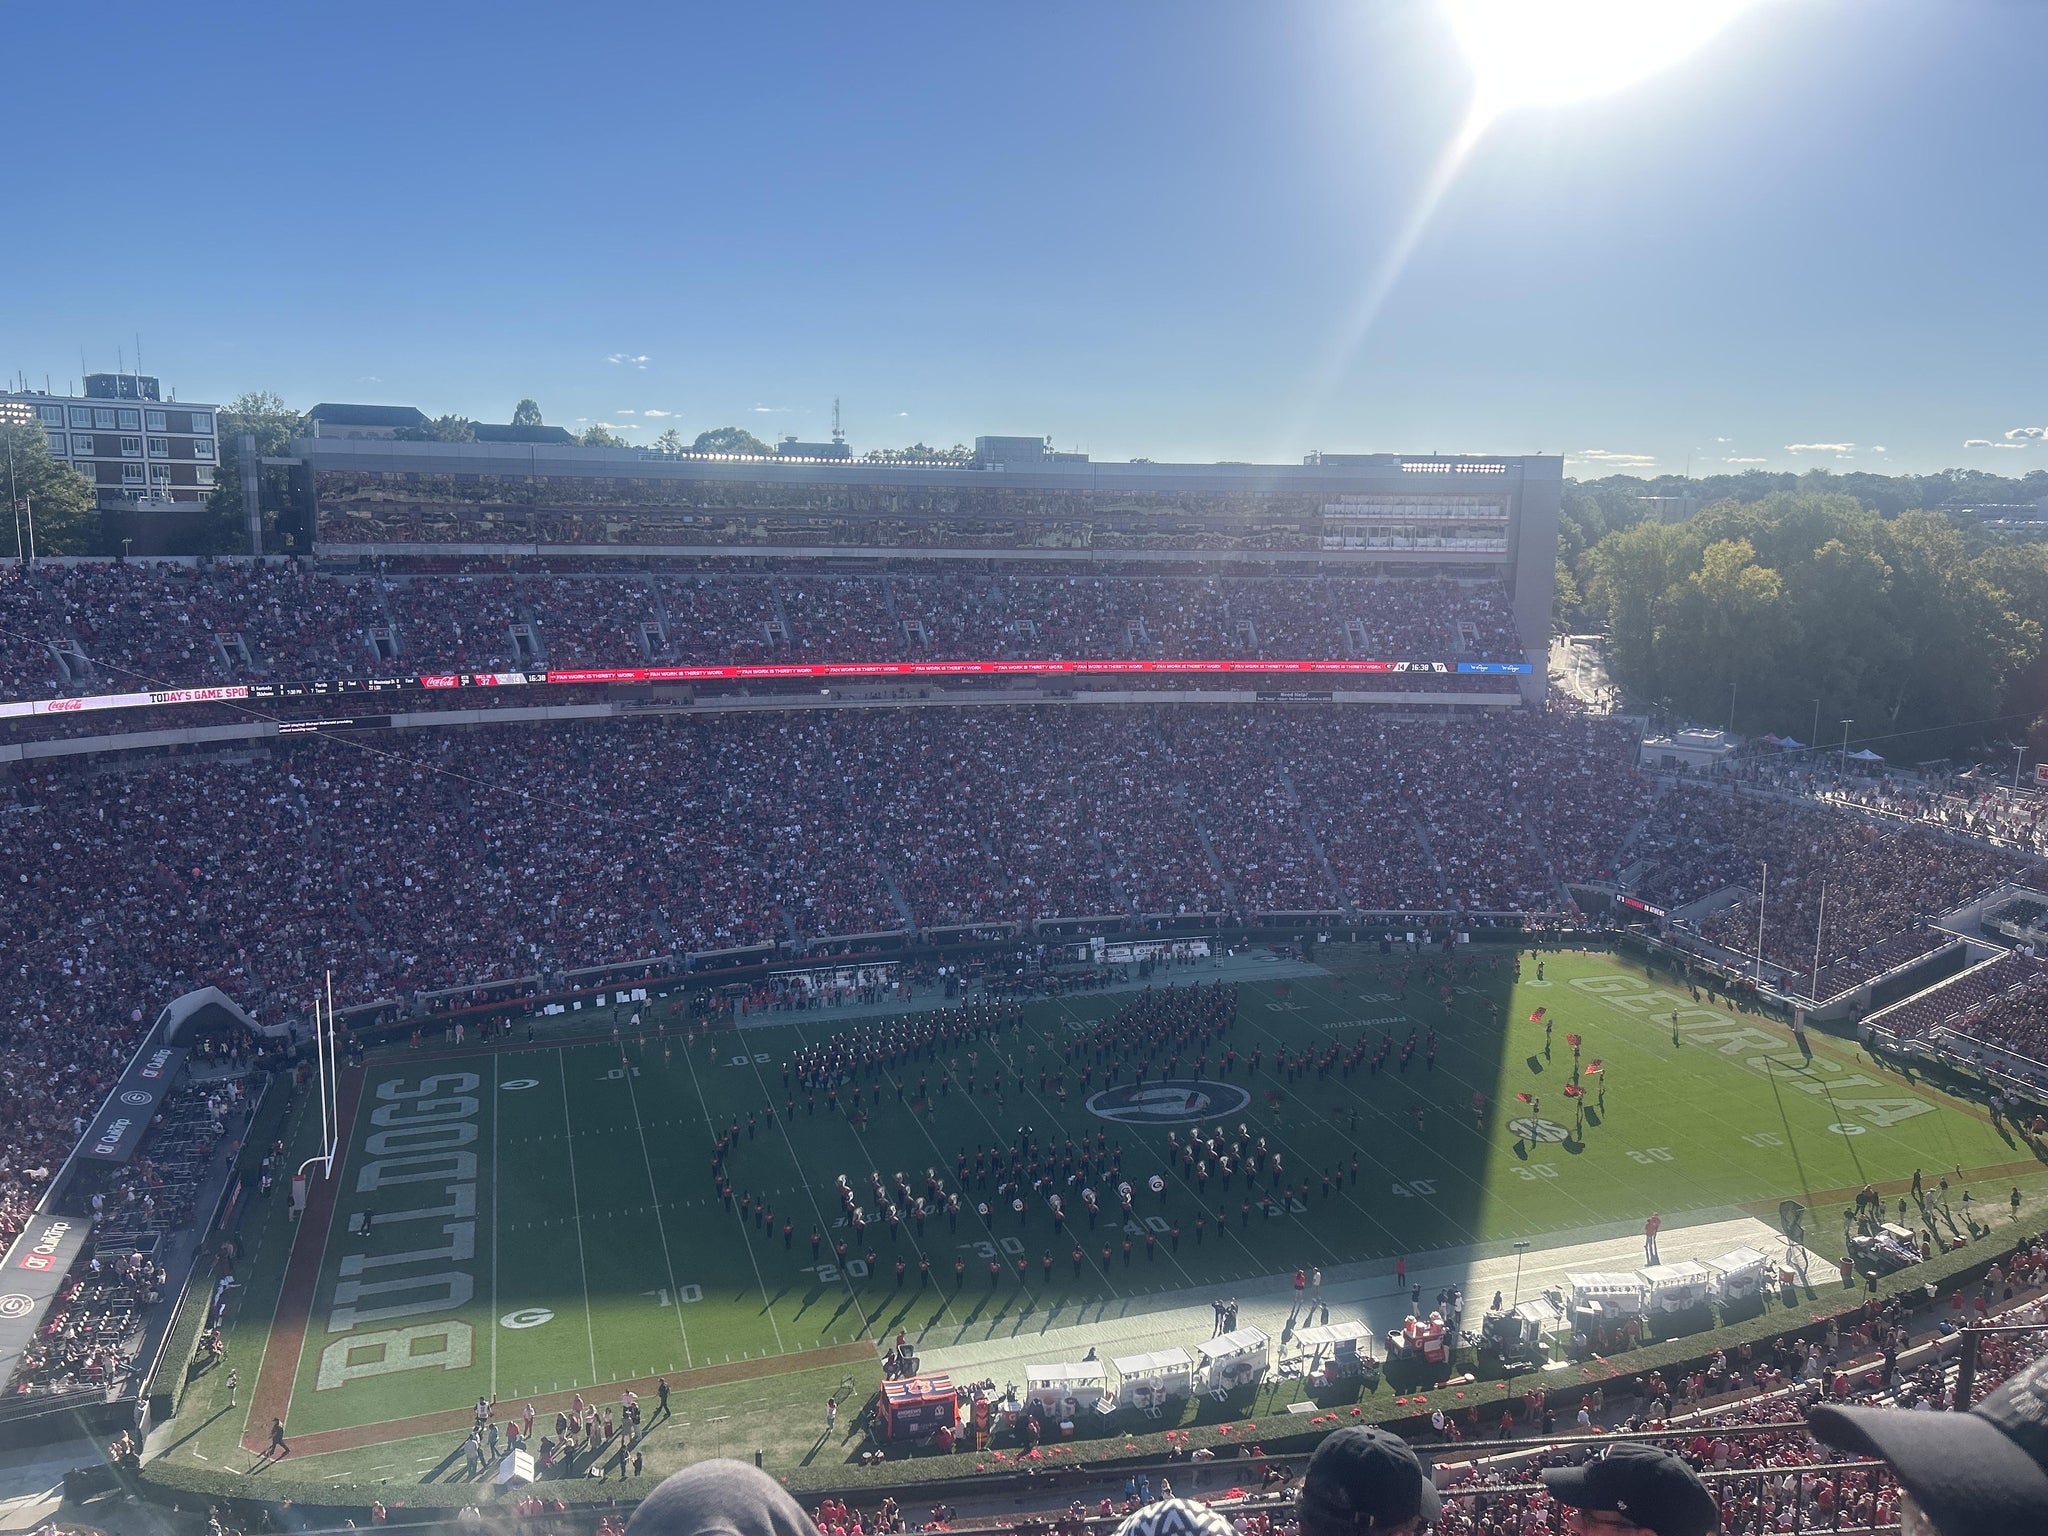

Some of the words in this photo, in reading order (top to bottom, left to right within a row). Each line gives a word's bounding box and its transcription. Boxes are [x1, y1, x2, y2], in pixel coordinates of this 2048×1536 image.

[150, 692, 191, 702] TODAY'S
[194, 689, 223, 699] GAME
[1322, 1016, 1406, 1030] PROGRESSIVE
[147, 1050, 173, 1068] QuikTrip
[731, 1053, 771, 1066] 20
[1568, 974, 1940, 1128] GEORGIA
[607, 1067, 641, 1080] 10
[101, 1119, 132, 1142] QuikTrip
[1741, 1134, 1783, 1148] 10
[1625, 1148, 1675, 1164] 20
[1509, 1166, 1558, 1181] 30
[1392, 1181, 1436, 1197] 40
[314, 1072, 480, 1391] BULLDOGS
[1123, 1216, 1170, 1235] 40
[33, 1222, 71, 1254] QuikTrip
[971, 1237, 1025, 1258] 30
[25, 1256, 48, 1269] QT
[815, 1260, 869, 1283] 20
[657, 1284, 703, 1307] 10
[500, 1308, 554, 1329] G
